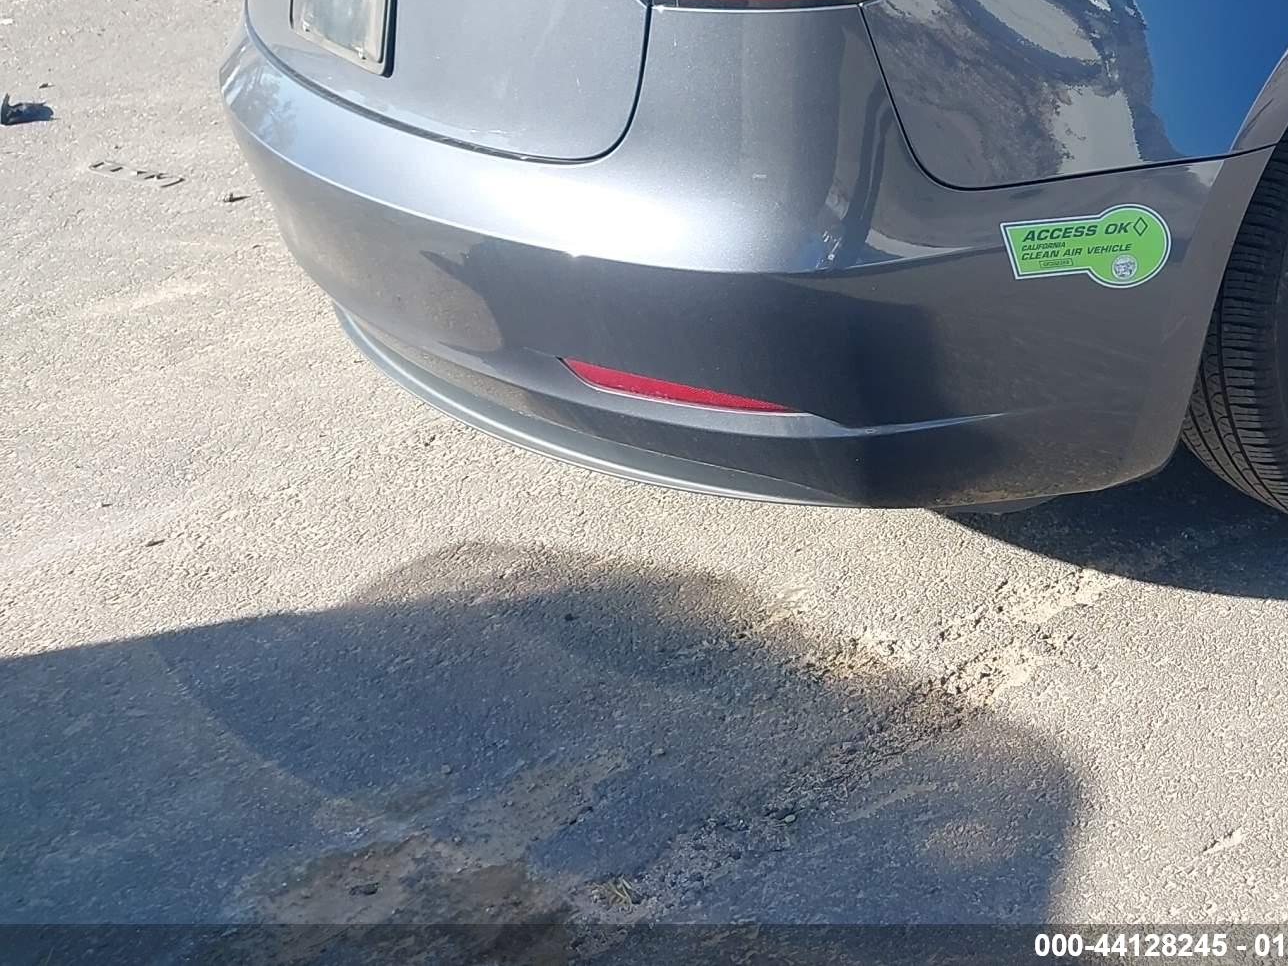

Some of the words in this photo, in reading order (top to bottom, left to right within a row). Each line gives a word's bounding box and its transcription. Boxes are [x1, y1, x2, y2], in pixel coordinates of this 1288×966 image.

[1022, 225, 1098, 242] ACCESS
[1104, 222, 1133, 235] OK
[1021, 241, 1066, 251] CALIFORNIA
[1021, 250, 1059, 260] CLEAN
[1063, 248, 1083, 256] AIR
[1087, 244, 1132, 254] VEHICLE
